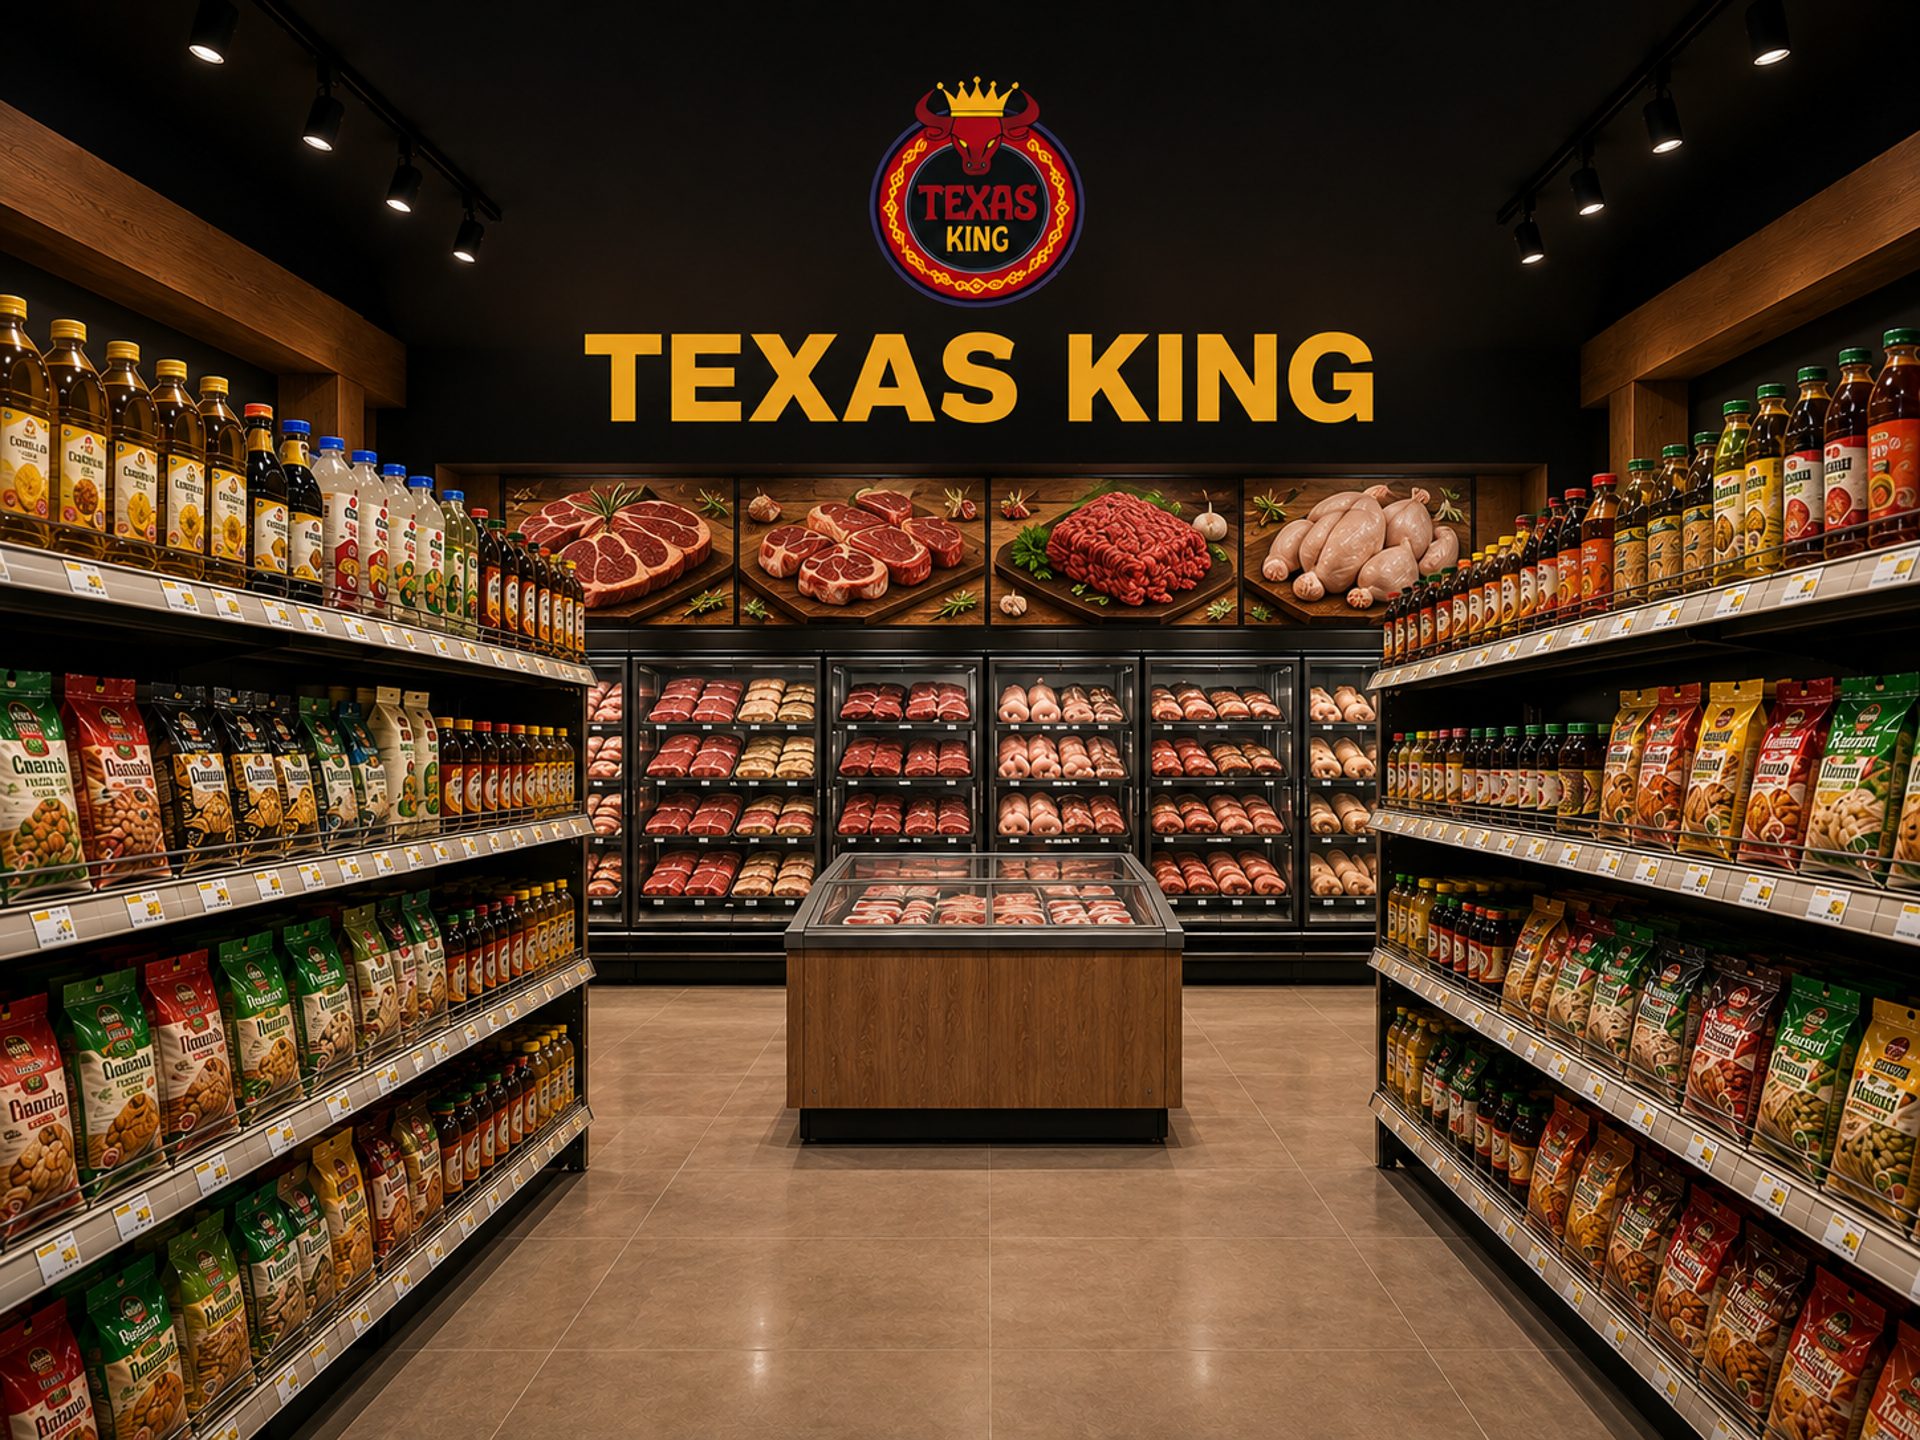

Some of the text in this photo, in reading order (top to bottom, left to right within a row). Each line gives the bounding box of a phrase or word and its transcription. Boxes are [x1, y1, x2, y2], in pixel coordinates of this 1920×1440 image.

[917, 184, 1038, 221] TEXAS
[946, 225, 1009, 252] KING
[584, 332, 1375, 423] TEXAS KING
